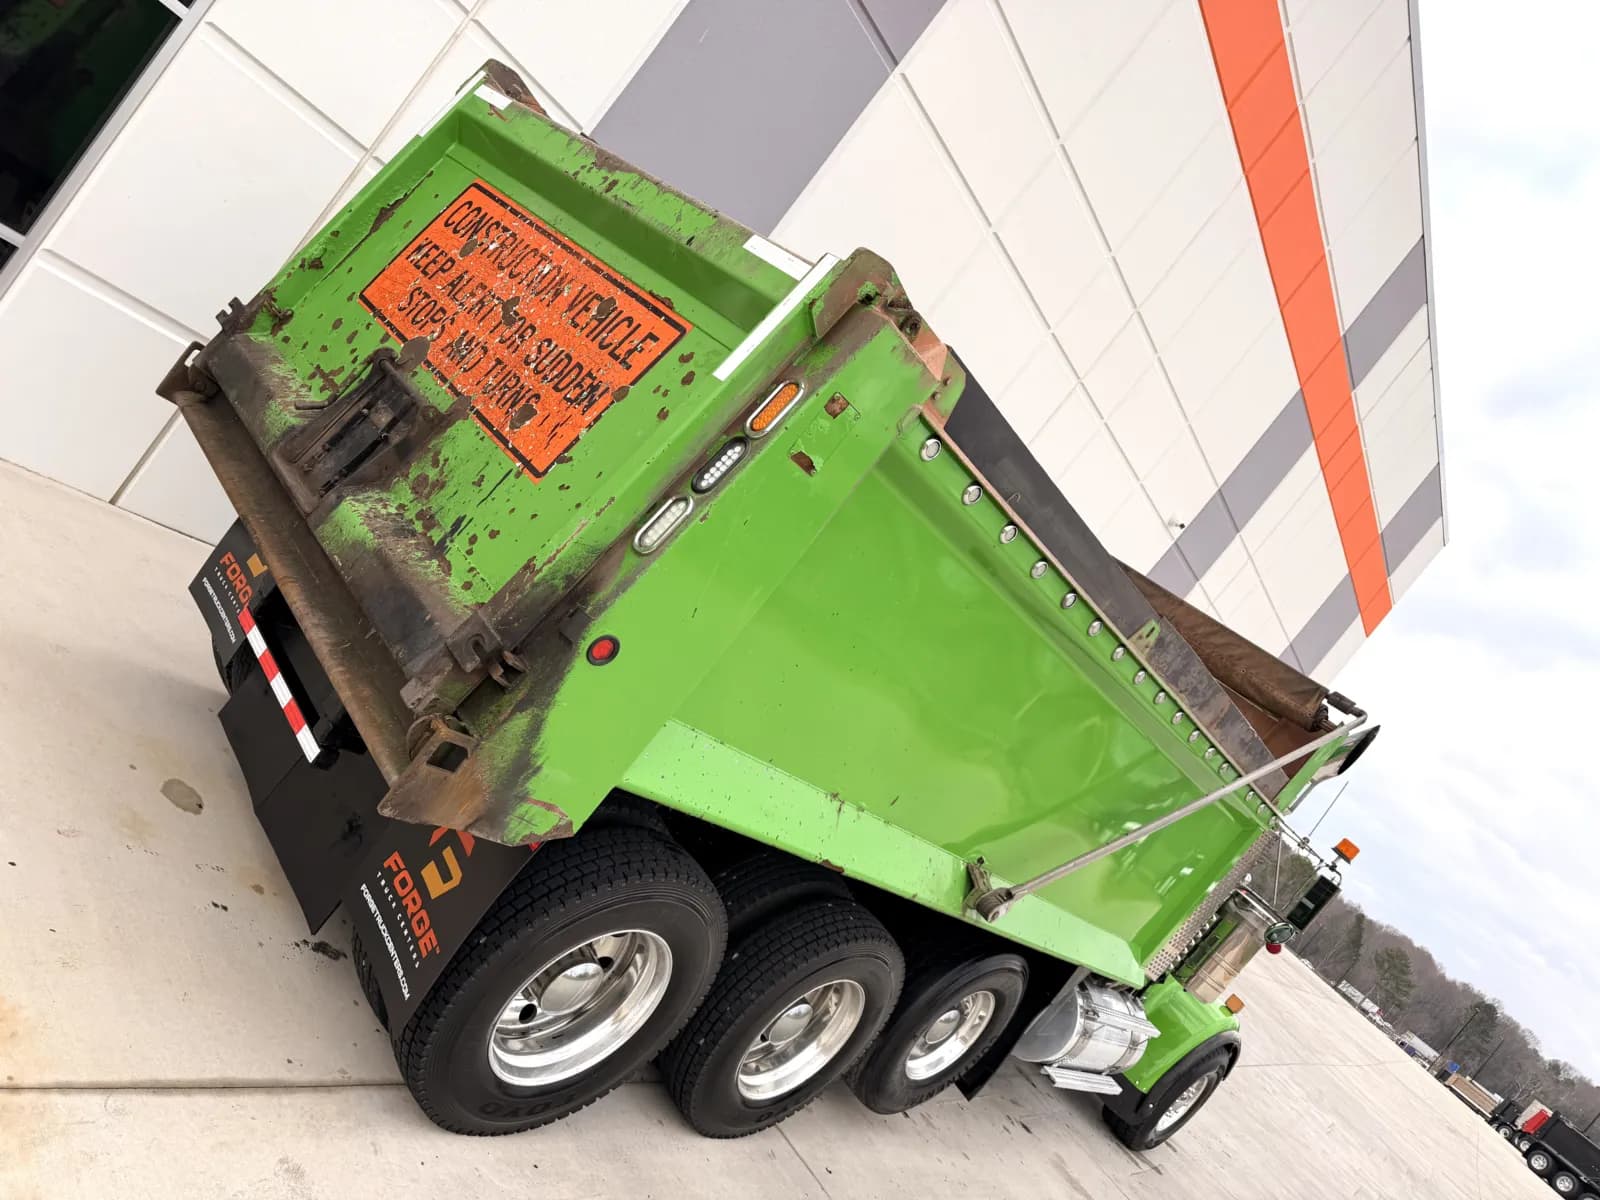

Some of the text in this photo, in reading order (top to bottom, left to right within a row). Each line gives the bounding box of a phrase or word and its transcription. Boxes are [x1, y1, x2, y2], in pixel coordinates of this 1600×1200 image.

[397, 286, 456, 340] STOPS
[441, 328, 489, 373] AND
[407, 238, 456, 280] KEEP
[444, 268, 504, 325] ALERT
[523, 337, 610, 415] SUDDEN
[443, 200, 660, 370] CONSTRUCTION VEHICLE
[220, 552, 253, 608] FORG
[360, 883, 411, 1001] FORGETRUCKCENTERS.COM
[376, 871, 420, 968] TRUCK CENTERS
